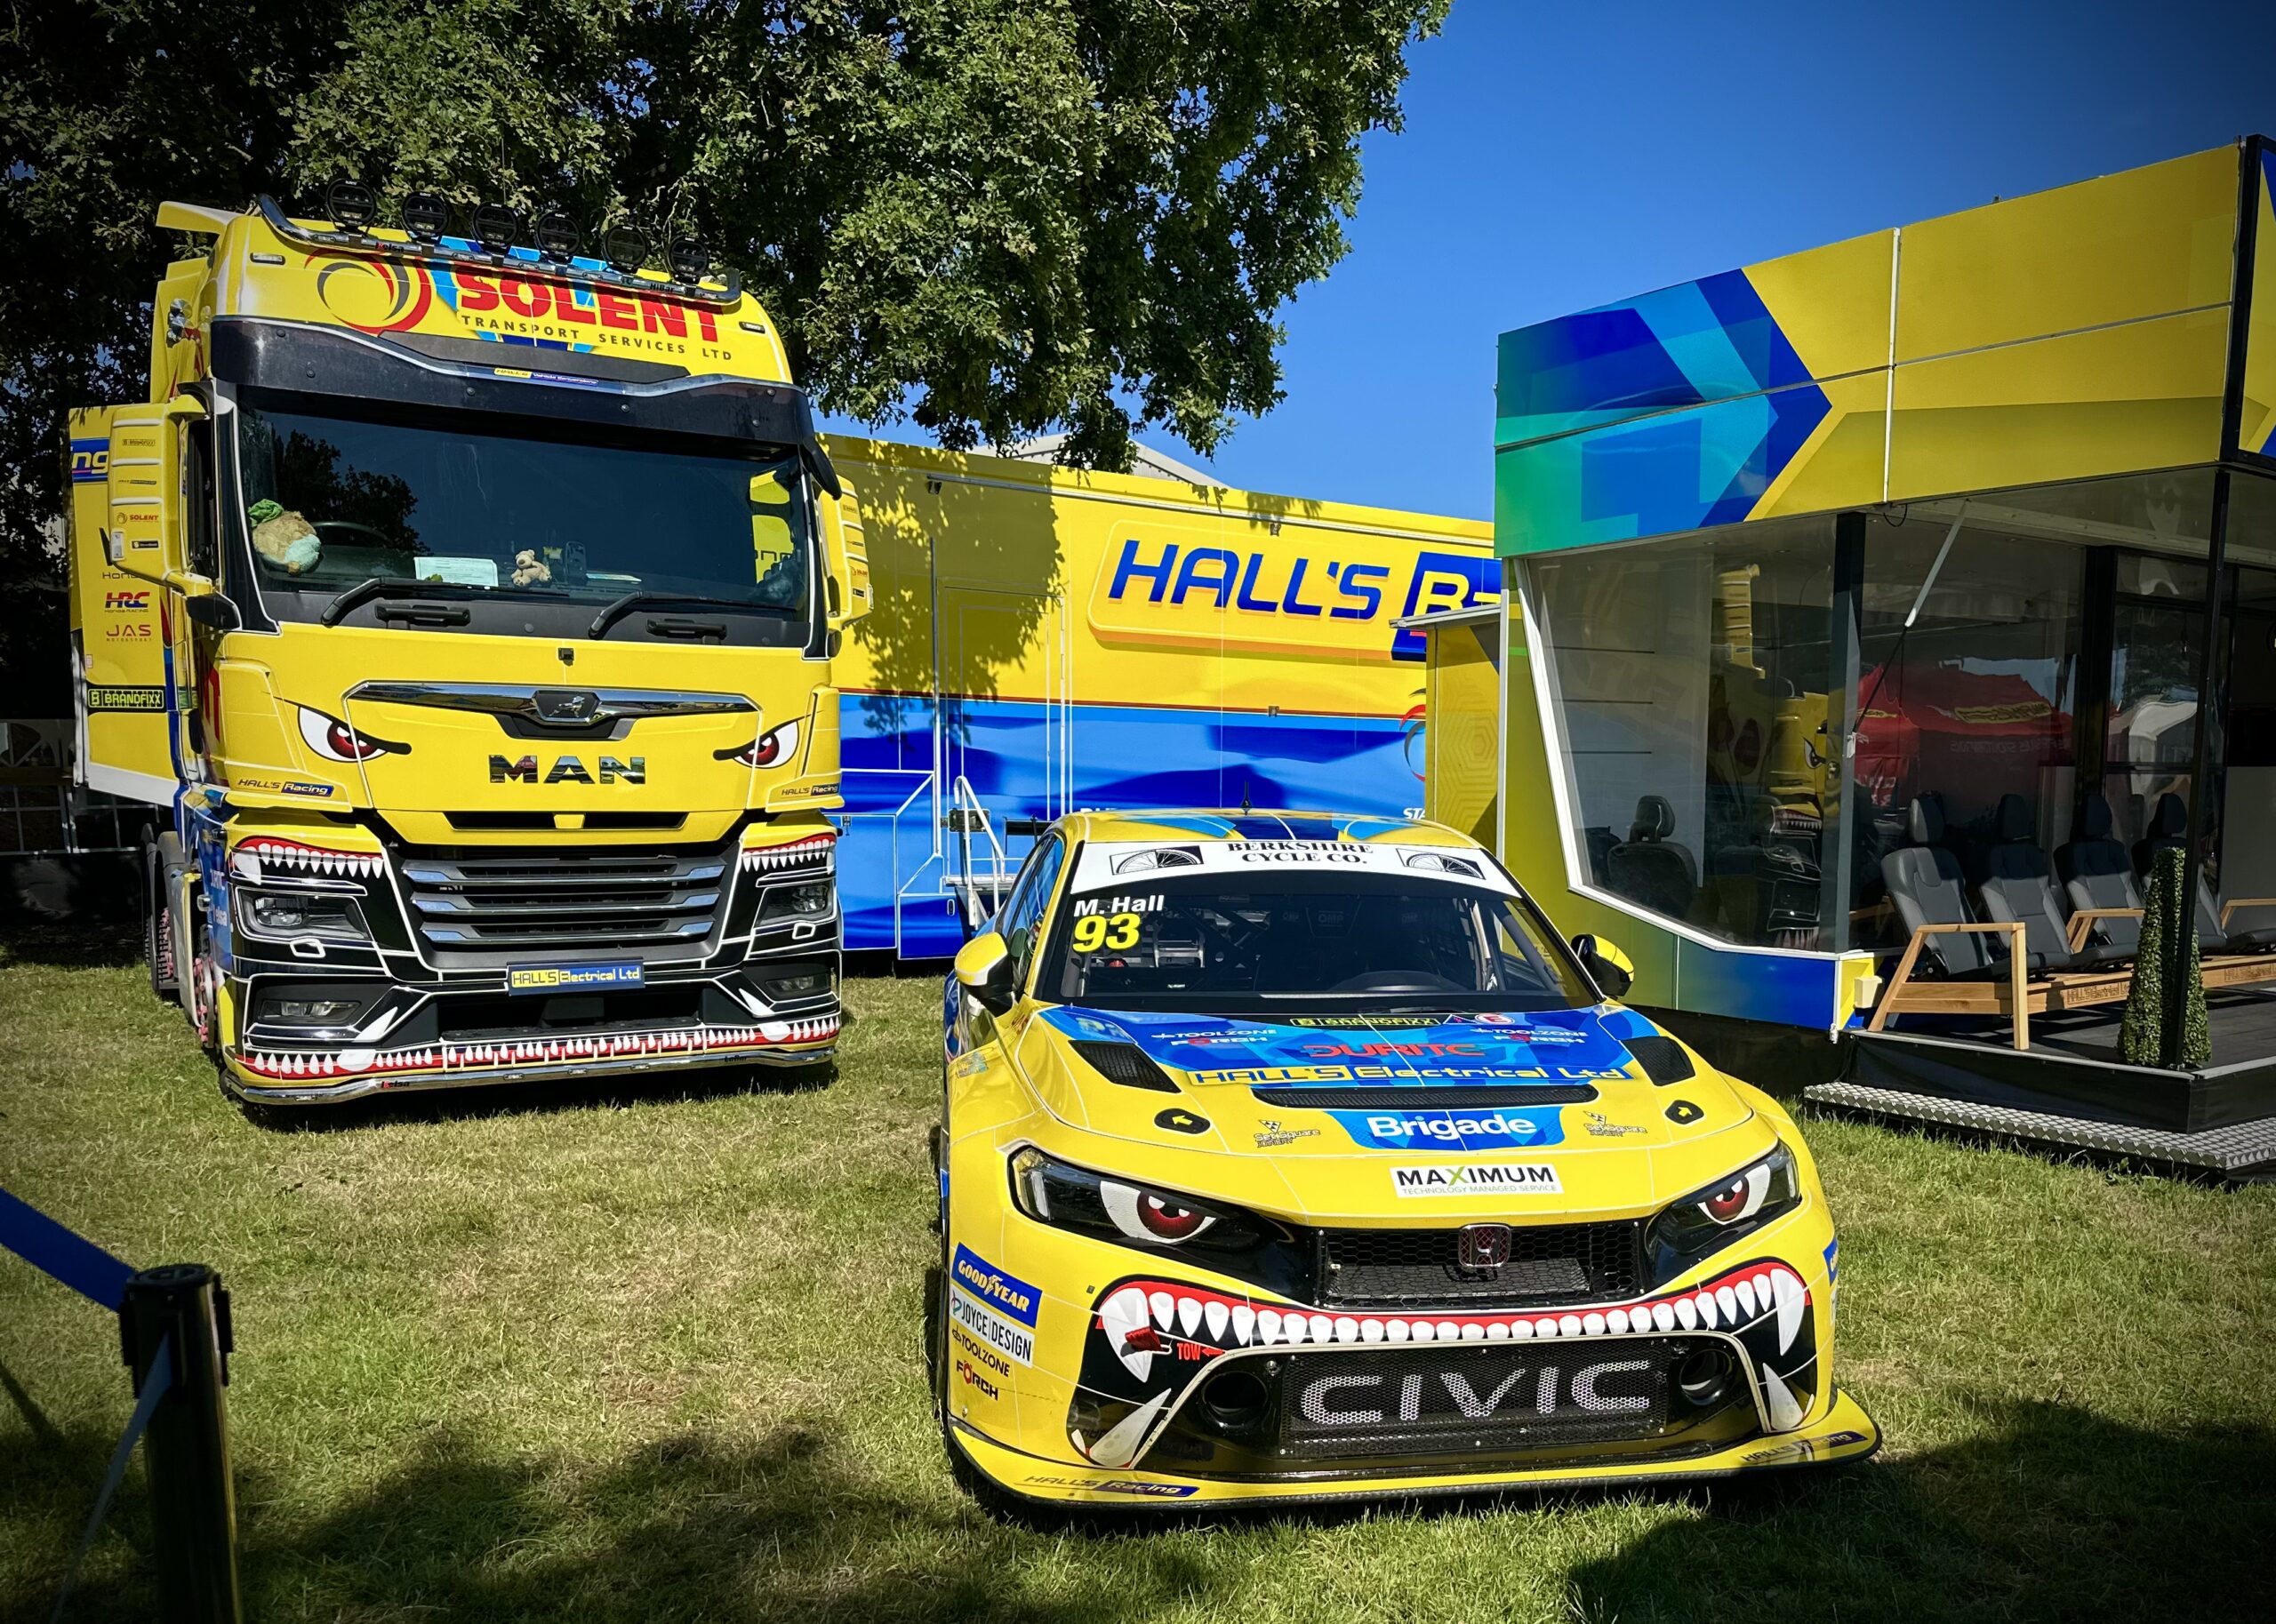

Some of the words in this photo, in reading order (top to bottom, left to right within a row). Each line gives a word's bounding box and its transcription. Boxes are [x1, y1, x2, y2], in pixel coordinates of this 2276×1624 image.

[455, 261, 718, 342] SOLENT
[461, 315, 580, 340] TRANSPORT
[599, 332, 685, 355] SERVICES
[702, 348, 732, 361] LTD
[1108, 539, 1390, 620] HALL'S
[105, 592, 150, 608] HRC
[106, 624, 151, 637] JAS
[105, 694, 161, 705] BRANDFIXX
[489, 755, 646, 784] MAN
[238, 779, 281, 789] HALL'S
[284, 782, 329, 795] Racing
[812, 785, 838, 796] Racing
[1227, 842, 1374, 853] BERKSHIRE
[1242, 852, 1321, 862] CYCLE
[1326, 854, 1367, 864] CO.
[1074, 899, 1105, 916] M.
[1111, 895, 1165, 913] Hall
[1072, 913, 1141, 953] 93
[513, 972, 557, 984] HALL'S
[559, 969, 616, 983] Electrical
[619, 967, 640, 980] Ltd
[1175, 1029, 1277, 1037] TOOLZONE
[1493, 1029, 1589, 1037] TOOLZONE
[1195, 1067, 1346, 1084] HALL'S
[1354, 1066, 1550, 1079] Electrical
[1559, 1068, 1625, 1080] Ltd
[1366, 1115, 1537, 1140] Brigade
[1397, 1166, 1554, 1187] MAXIMUM
[1403, 1186, 1467, 1196] TECHNOLOGY
[1519, 1184, 1557, 1192] SERVICE
[958, 1260, 1030, 1312] GOODYEAR
[961, 1300, 989, 1337] JOYCE
[991, 1323, 1031, 1362] DESIGN
[960, 1333, 1010, 1377] TOOLZONE
[1176, 1342, 1200, 1361] TOW
[1301, 1359, 1652, 1424] CIVIC
[1108, 1482, 1181, 1494] Racing
